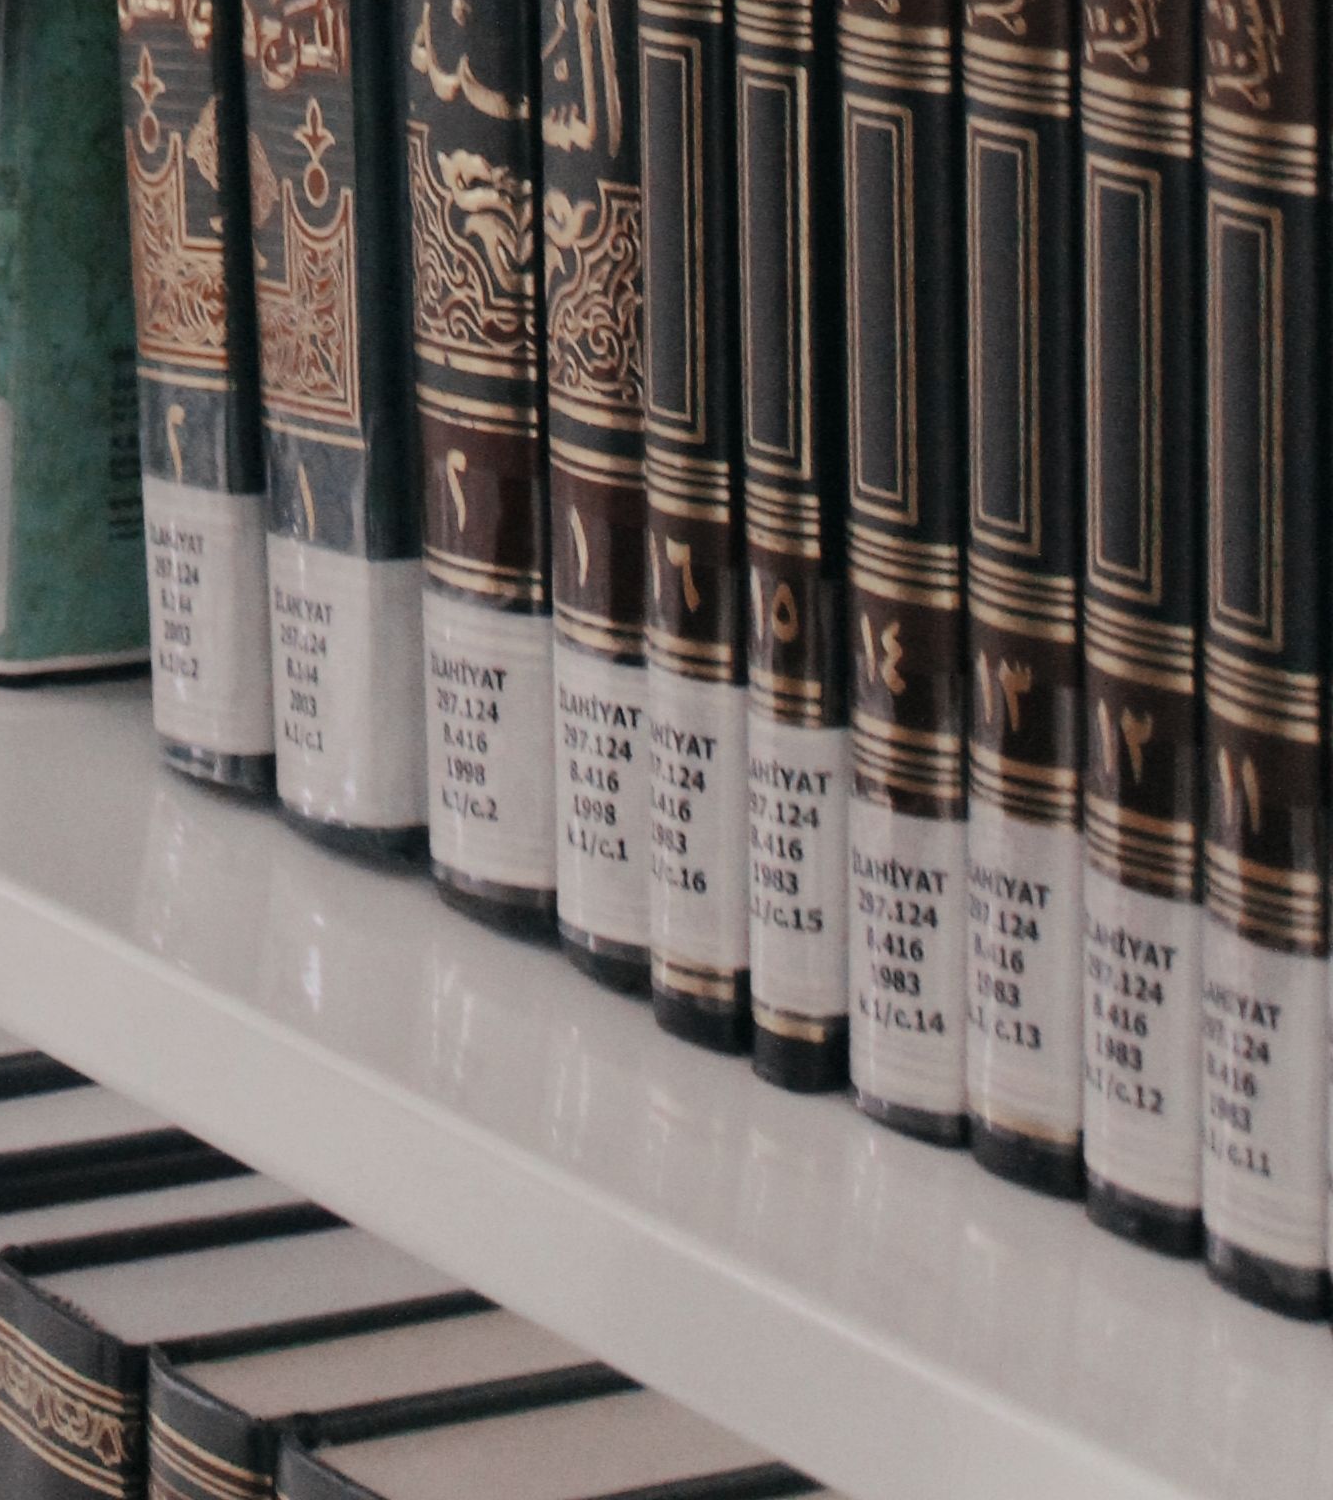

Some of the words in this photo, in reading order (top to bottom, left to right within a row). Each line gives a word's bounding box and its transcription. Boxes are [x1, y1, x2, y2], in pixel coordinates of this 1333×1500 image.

[298, 460, 316, 542] ١
[446, 449, 467, 533] ٢
[570, 505, 589, 588] ١
[650, 528, 701, 614] ١٦
[751, 564, 798, 643] ١٥
[860, 611, 907, 695] ١٤
[978, 648, 1032, 731] ١٣
[558, 681, 643, 732] İLAHİYAT
[564, 724, 633, 764] 297.124
[1098, 698, 1153, 783] ١٢
[447, 756, 486, 787] 1998
[574, 793, 618, 826] 1998
[1218, 744, 1262, 834] ١١
[753, 861, 799, 896] 1983
[852, 845, 949, 896] İLAHİYAT
[859, 886, 939, 929] 297.124
